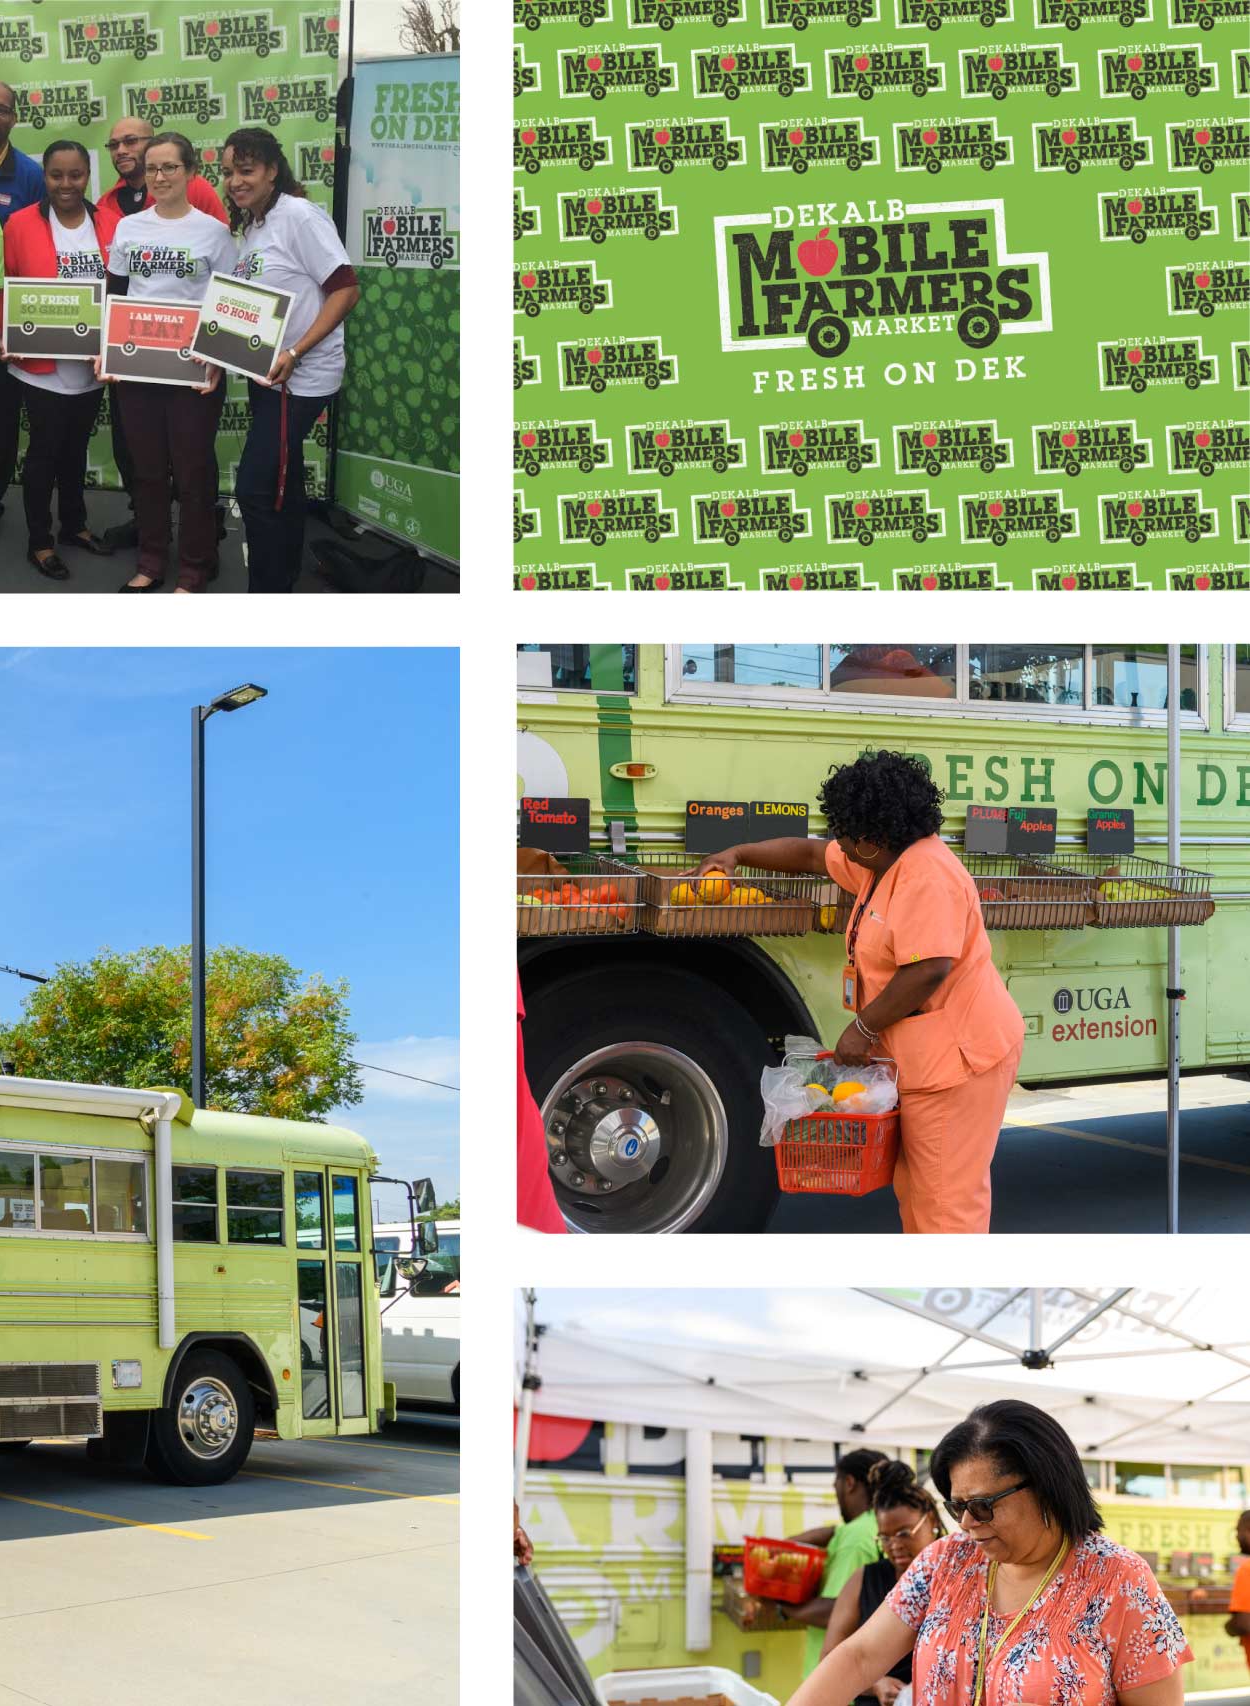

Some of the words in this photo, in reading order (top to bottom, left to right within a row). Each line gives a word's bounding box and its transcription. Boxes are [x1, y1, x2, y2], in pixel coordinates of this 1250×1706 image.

[74, 31, 158, 57] FARMERS
[194, 28, 282, 55] FARMERS
[578, 43, 626, 54] DEKALB
[846, 43, 894, 54] DEKALB
[574, 68, 672, 93] FARMERS
[842, 68, 940, 93] FARMERS
[606, 84, 643, 93] MARKET
[874, 84, 911, 93] MARKET
[370, 115, 407, 141] ON
[1118, 186, 1166, 197] DEKALB
[377, 206, 416, 216] DEKALB
[773, 199, 905, 228] DEKALB
[1114, 211, 1212, 236] FARMERS
[1146, 227, 1183, 236] MARKET
[372, 237, 454, 260] FARMERS
[398, 253, 431, 262] MARKET
[133, 261, 194, 274] FARMERS
[20, 293, 38, 305] SO
[40, 294, 80, 306] FRESH
[761, 268, 1033, 336] FARMERS
[20, 304, 37, 316] SO
[39, 305, 80, 316] GREEN
[215, 302, 229, 314] GO
[230, 306, 260, 325] HOME
[137, 313, 153, 322] AM
[154, 313, 185, 324] WHAT
[128, 321, 139, 337] I
[145, 322, 182, 340] EAT
[852, 315, 955, 338] MARKET
[578, 336, 626, 347] DEKALB
[574, 361, 672, 386] FARMERS
[753, 366, 865, 394] FRESH
[884, 362, 936, 386] ON
[955, 356, 1027, 382] DEK
[606, 377, 643, 386] MARKET
[914, 419, 962, 430] DEKALB
[910, 444, 1008, 469] FARMERS
[942, 460, 979, 469] MARKET
[385, 474, 412, 497] UGA
[712, 489, 760, 500] DEKALB
[708, 514, 806, 539] FARMERS
[740, 530, 777, 539] MARKET
[875, 751, 1055, 803] ESH
[1088, 760, 1168, 805] ON
[523, 799, 549, 811] Red
[689, 803, 744, 820] Oranges
[756, 803, 807, 817] LEMONS
[529, 811, 577, 825] Tomato
[1009, 808, 1027, 821] Fuji
[1088, 809, 1121, 822] Granny
[1020, 820, 1053, 832] Apples
[1096, 819, 1125, 831] Apples
[1077, 986, 1131, 1012] UGA
[1052, 1015, 1157, 1042] extension
[1120, 1522, 1212, 1549] FRESH
